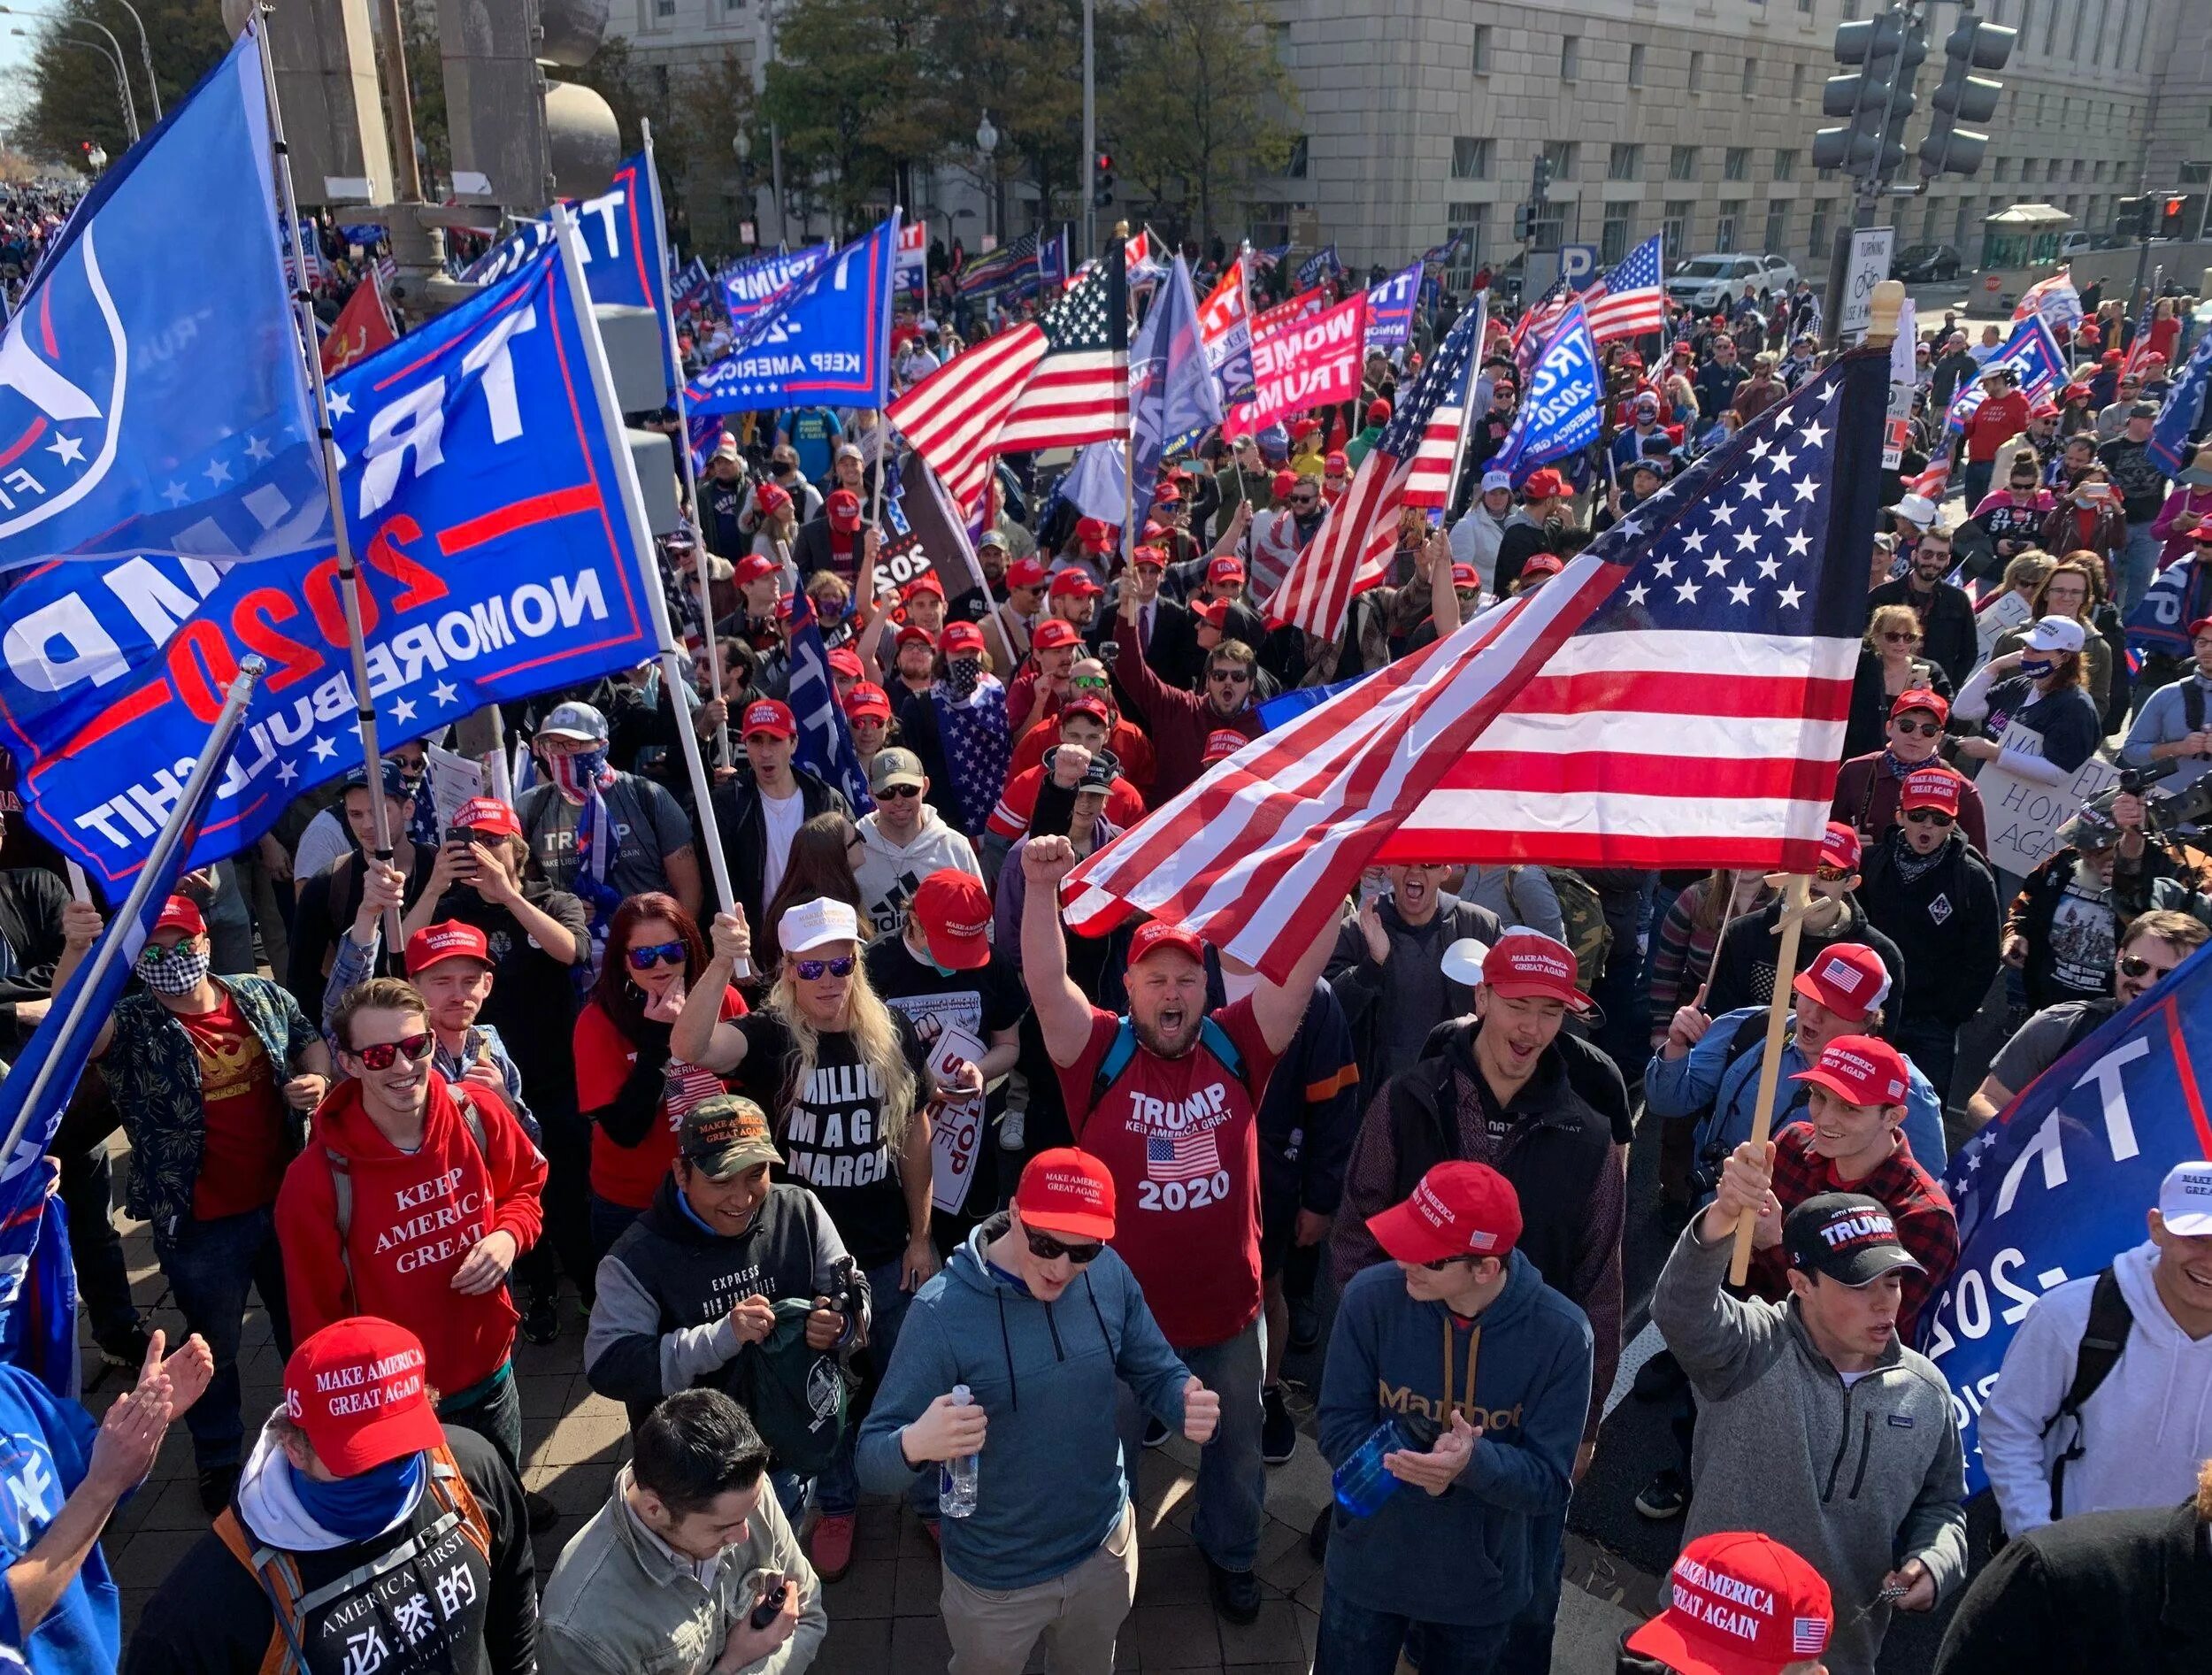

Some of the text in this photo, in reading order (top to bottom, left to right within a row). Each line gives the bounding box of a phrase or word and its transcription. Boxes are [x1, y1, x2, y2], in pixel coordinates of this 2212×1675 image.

[1860, 240, 1886, 257] TURNING
[1563, 248, 1592, 277] P
[1217, 562, 1239, 573] USA
[1909, 775, 1957, 788] MAKE AMERICA
[1910, 785, 1954, 796] GREAT AGAIN
[472, 801, 504, 812] AMERICA
[478, 810, 503, 821] AGAIN
[945, 920, 964, 929] MAKE
[947, 928, 966, 937] GREAT
[426, 931, 479, 944] MAKE AMERICA
[431, 938, 478, 950] GREAT AGAIN
[1510, 954, 1570, 971] MAKE AMERICA
[1515, 963, 1567, 978] GREAT AGAIN
[1839, 1049, 1876, 1075] AMERICA
[1840, 1064, 1867, 1081] AGAIN
[1129, 1082, 1227, 1130] TRUMP
[698, 1118, 727, 1135] MAKE
[728, 1115, 764, 1130] AMERICA
[1201, 1108, 1233, 1128] GREAT
[707, 1125, 765, 1144] GREAT AGAIN
[787, 1143, 888, 1187] MARCH
[394, 1166, 464, 1213] KEEP
[1045, 1172, 1104, 1189] MAKE AMERICA
[1048, 1181, 1101, 1198] GREAT AGAIN
[1138, 1169, 1231, 1212] 2020
[1419, 1202, 1444, 1229] AGAIN
[1424, 1187, 1455, 1225] AMERICA
[373, 1186, 493, 1256] AMERICA
[1820, 1216, 1893, 1247] TRUMP
[396, 1222, 486, 1274] GREAT
[711, 1264, 761, 1292] EXPRESS
[703, 1296, 724, 1318] NEW
[753, 1276, 777, 1297] CITY
[315, 1348, 425, 1393] MAKE AMERICA
[328, 1373, 421, 1418] GREAT AGAIN
[322, 1530, 465, 1639] AMERICA FIRST
[1672, 1554, 1774, 1617] MAKE AMERICA
[1672, 1582, 1761, 1642] GREAT AGAIN
